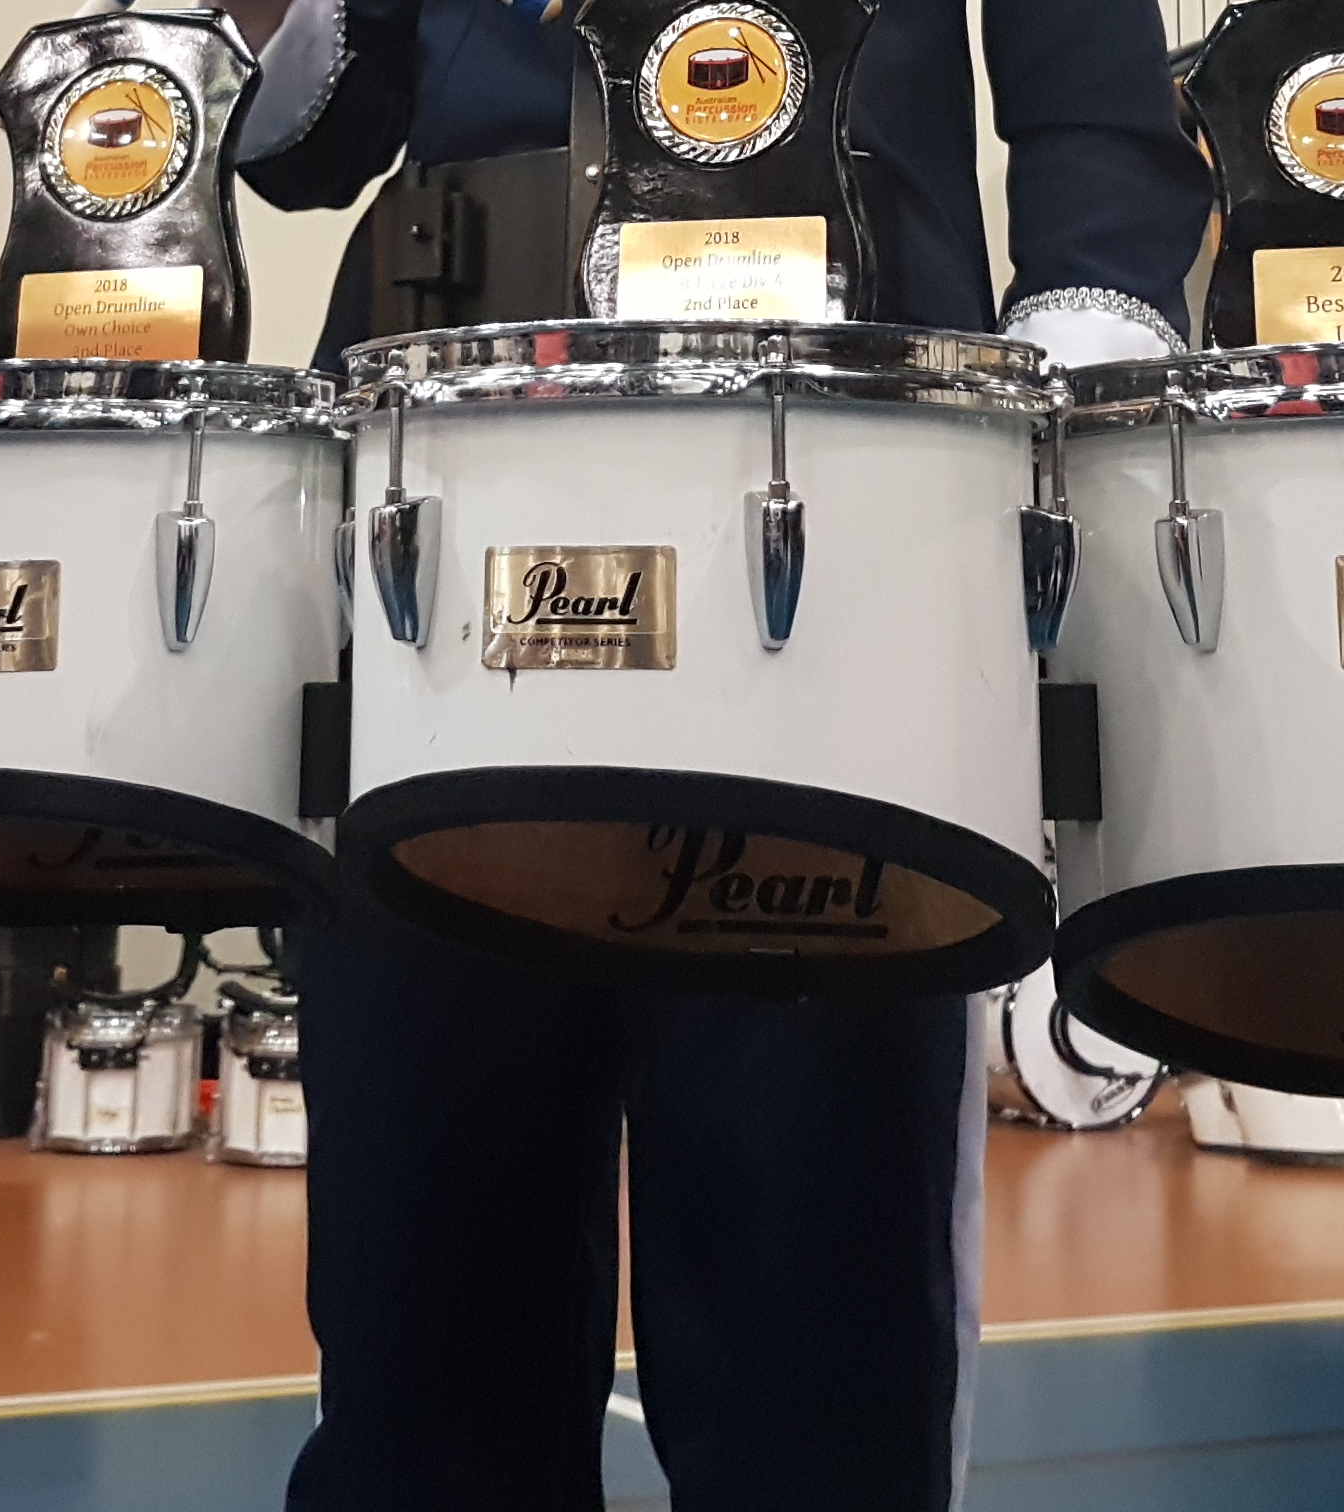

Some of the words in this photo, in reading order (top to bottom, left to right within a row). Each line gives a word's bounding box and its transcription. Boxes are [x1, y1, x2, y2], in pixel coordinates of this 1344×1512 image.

[686, 102, 757, 115] Percussion
[705, 231, 740, 245] 2018
[662, 254, 703, 271] Open
[707, 251, 781, 267] Drumline
[94, 279, 128, 293] 2018
[54, 303, 91, 319] Open
[96, 296, 166, 314] Drumline
[684, 294, 713, 311] 2nd
[717, 294, 758, 310] Place
[64, 323, 98, 336] Own
[102, 320, 152, 336] Choice
[104, 342, 143, 358] Place
[507, 561, 643, 625] Pearl
[594, 637, 632, 647] SERIES
[608, 825, 884, 932] Pearl
